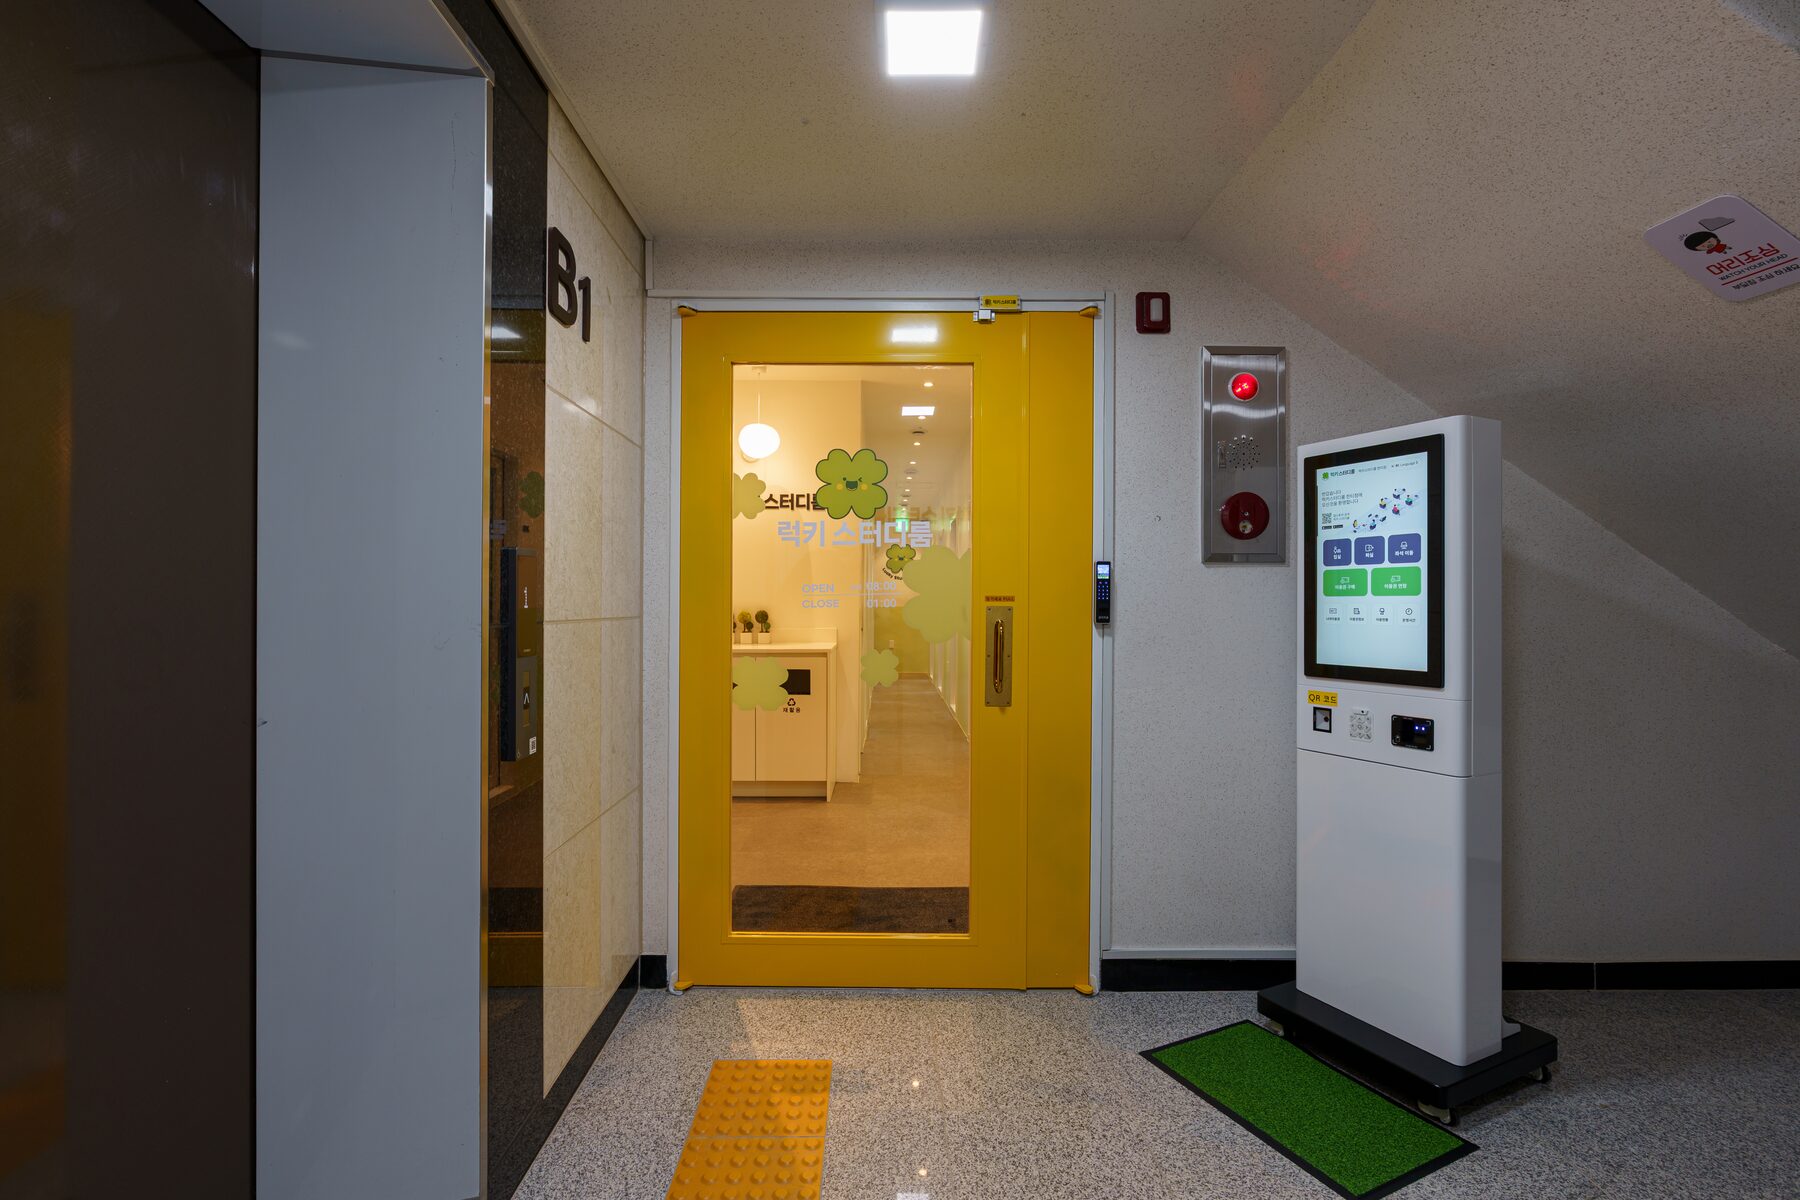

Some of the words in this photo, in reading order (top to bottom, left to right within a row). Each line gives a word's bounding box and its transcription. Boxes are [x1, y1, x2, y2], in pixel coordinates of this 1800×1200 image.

[1706, 243, 1780, 275] 머리조심
[1719, 269, 1744, 281] WATCH
[1744, 261, 1764, 272] YOUR
[1764, 253, 1788, 264] HEAD
[1757, 273, 1775, 282] 조심
[547, 226, 592, 343] B1
[1330, 469, 1355, 477] 럭키스터디룸
[777, 520, 826, 548] 럭키
[831, 520, 934, 548] 스터디룸
[802, 583, 835, 593] OPEN
[801, 600, 839, 609] CLOSE
[1308, 694, 1320, 702] QR
[1323, 696, 1337, 704] 코드
